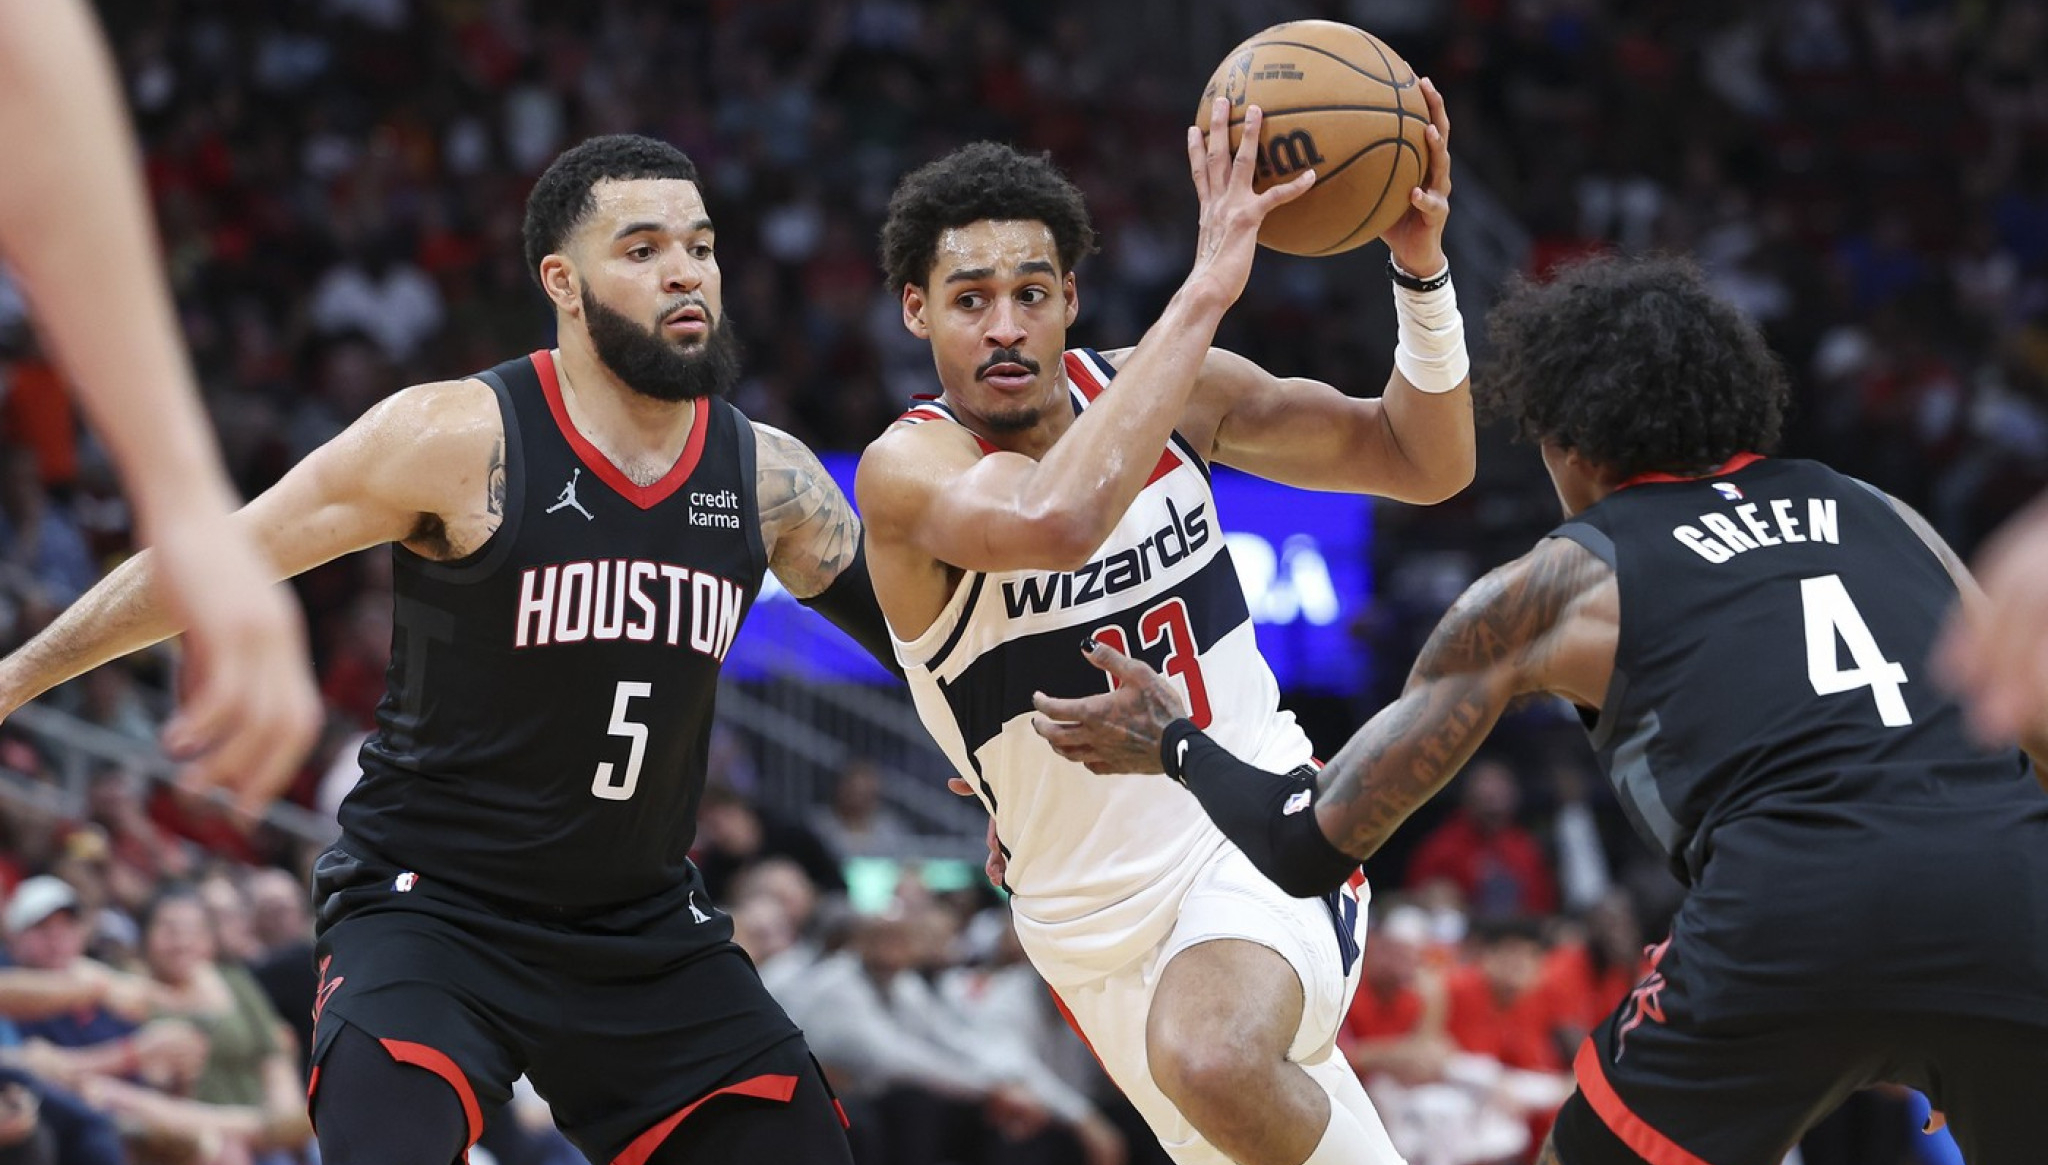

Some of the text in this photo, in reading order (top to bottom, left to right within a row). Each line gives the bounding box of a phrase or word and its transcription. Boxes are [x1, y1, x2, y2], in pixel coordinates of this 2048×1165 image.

[688, 507, 740, 530] karma
[690, 490, 738, 510] credit
[1672, 498, 1840, 564] GREEN
[514, 557, 743, 664] HOUSTON
[1800, 573, 1913, 727] 4
[591, 680, 652, 801] 5
